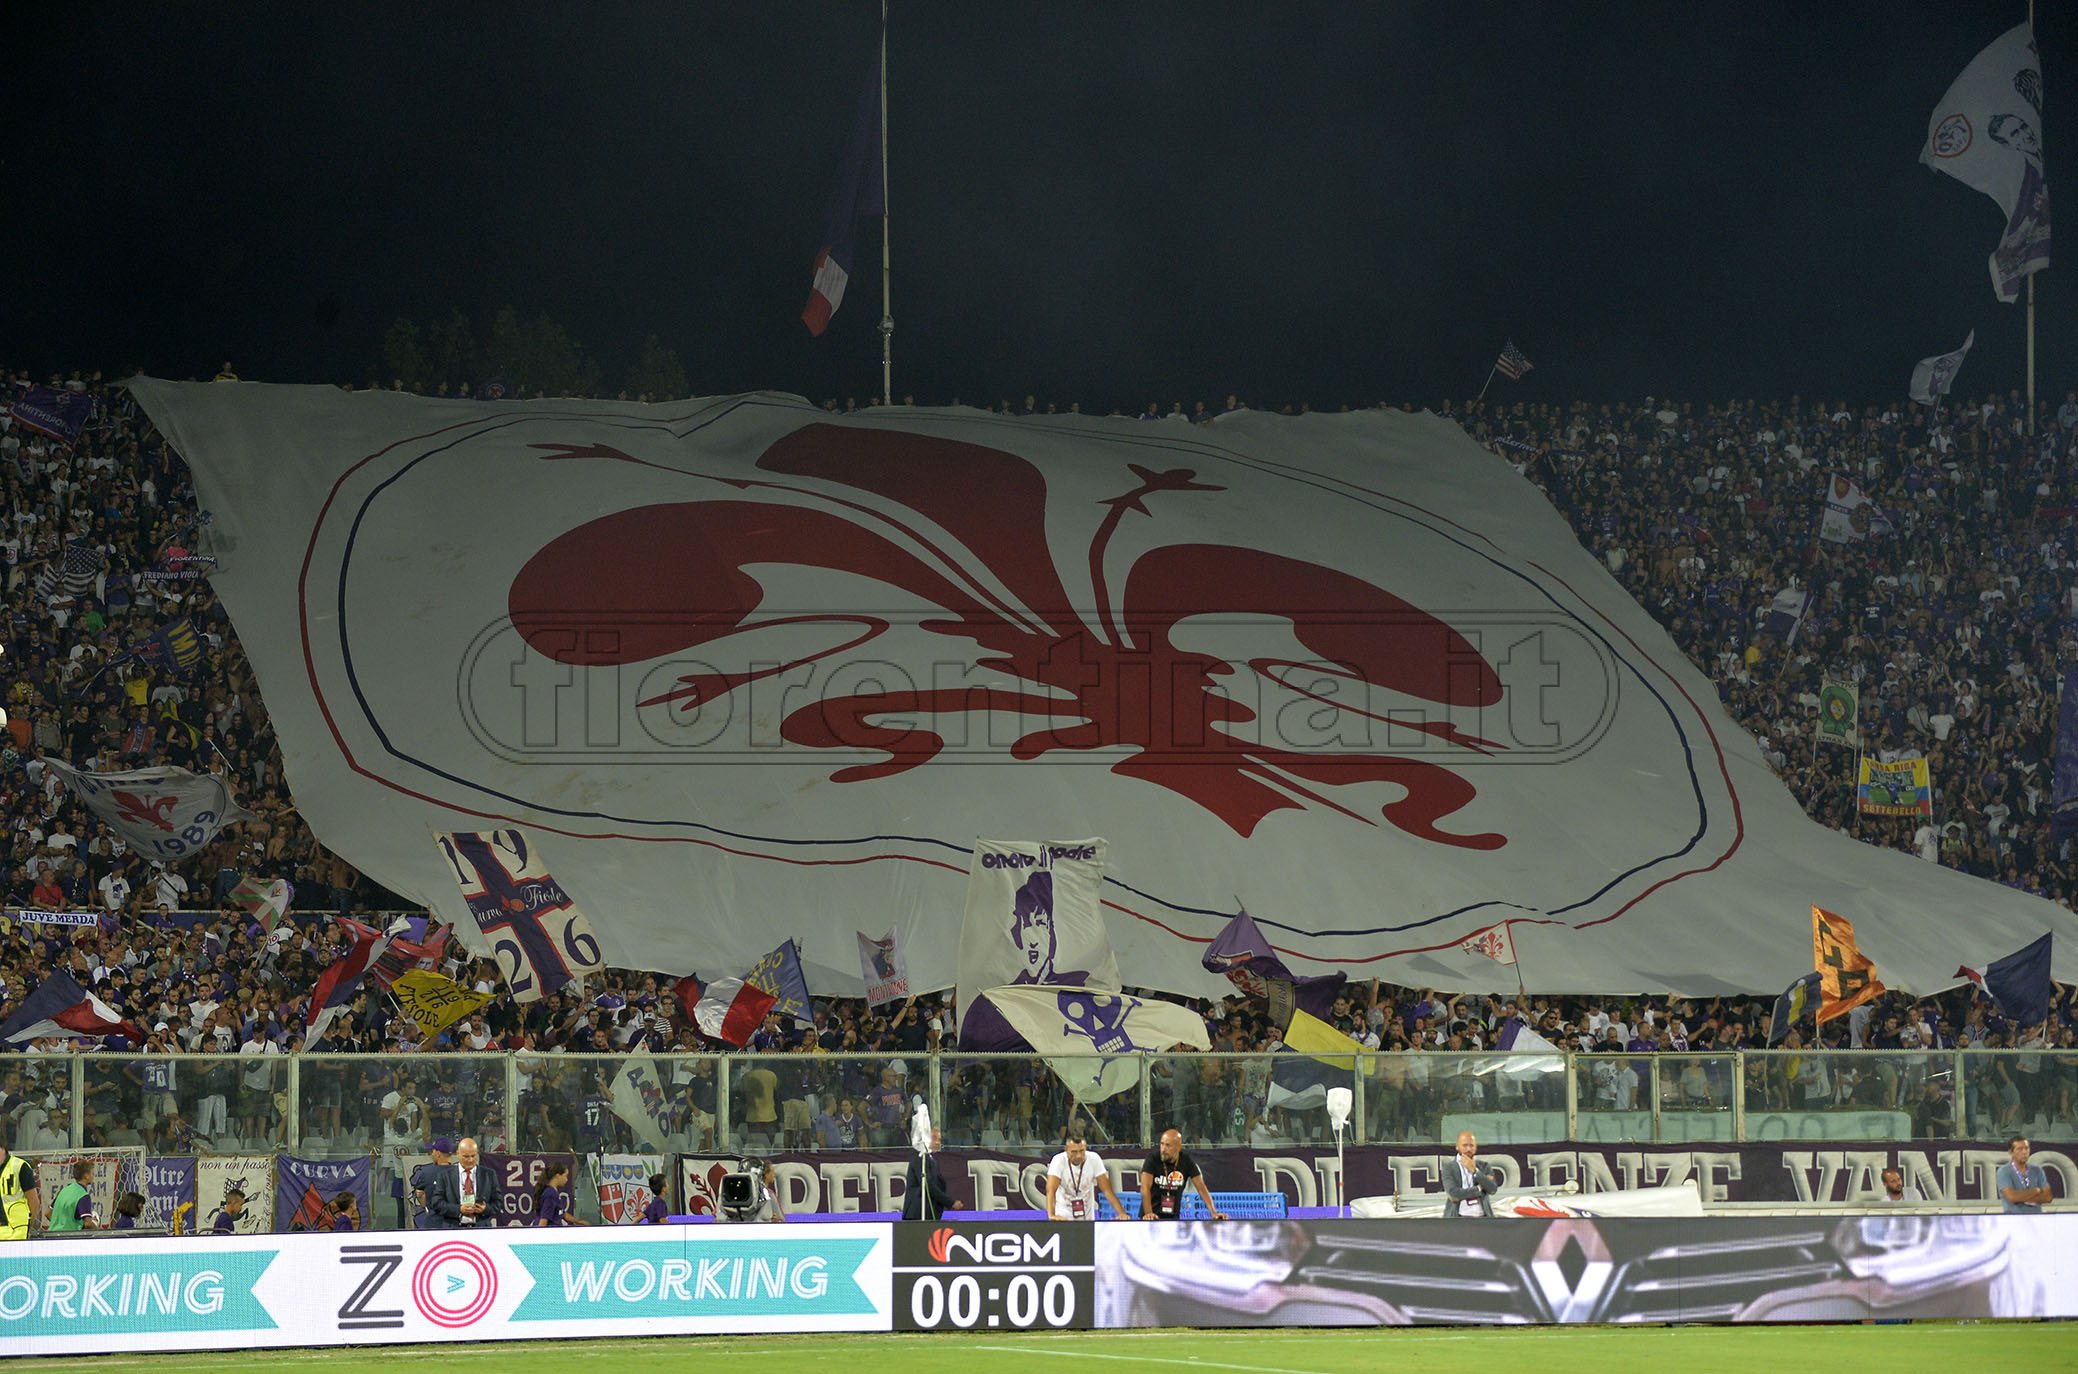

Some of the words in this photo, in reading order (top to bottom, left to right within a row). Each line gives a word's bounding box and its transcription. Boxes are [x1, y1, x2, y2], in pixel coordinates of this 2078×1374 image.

[152, 812, 215, 855] 1989
[22, 912, 54, 923] JUVE
[55, 914, 95, 925] MERDA
[290, 1162, 356, 1179] CURVA
[1388, 1152, 1741, 1203] FRENZE
[145, 1190, 178, 1216] gni
[945, 1232, 1061, 1263] NGM
[561, 1256, 829, 1303] WORKING
[911, 1275, 1076, 1328] 00:00
